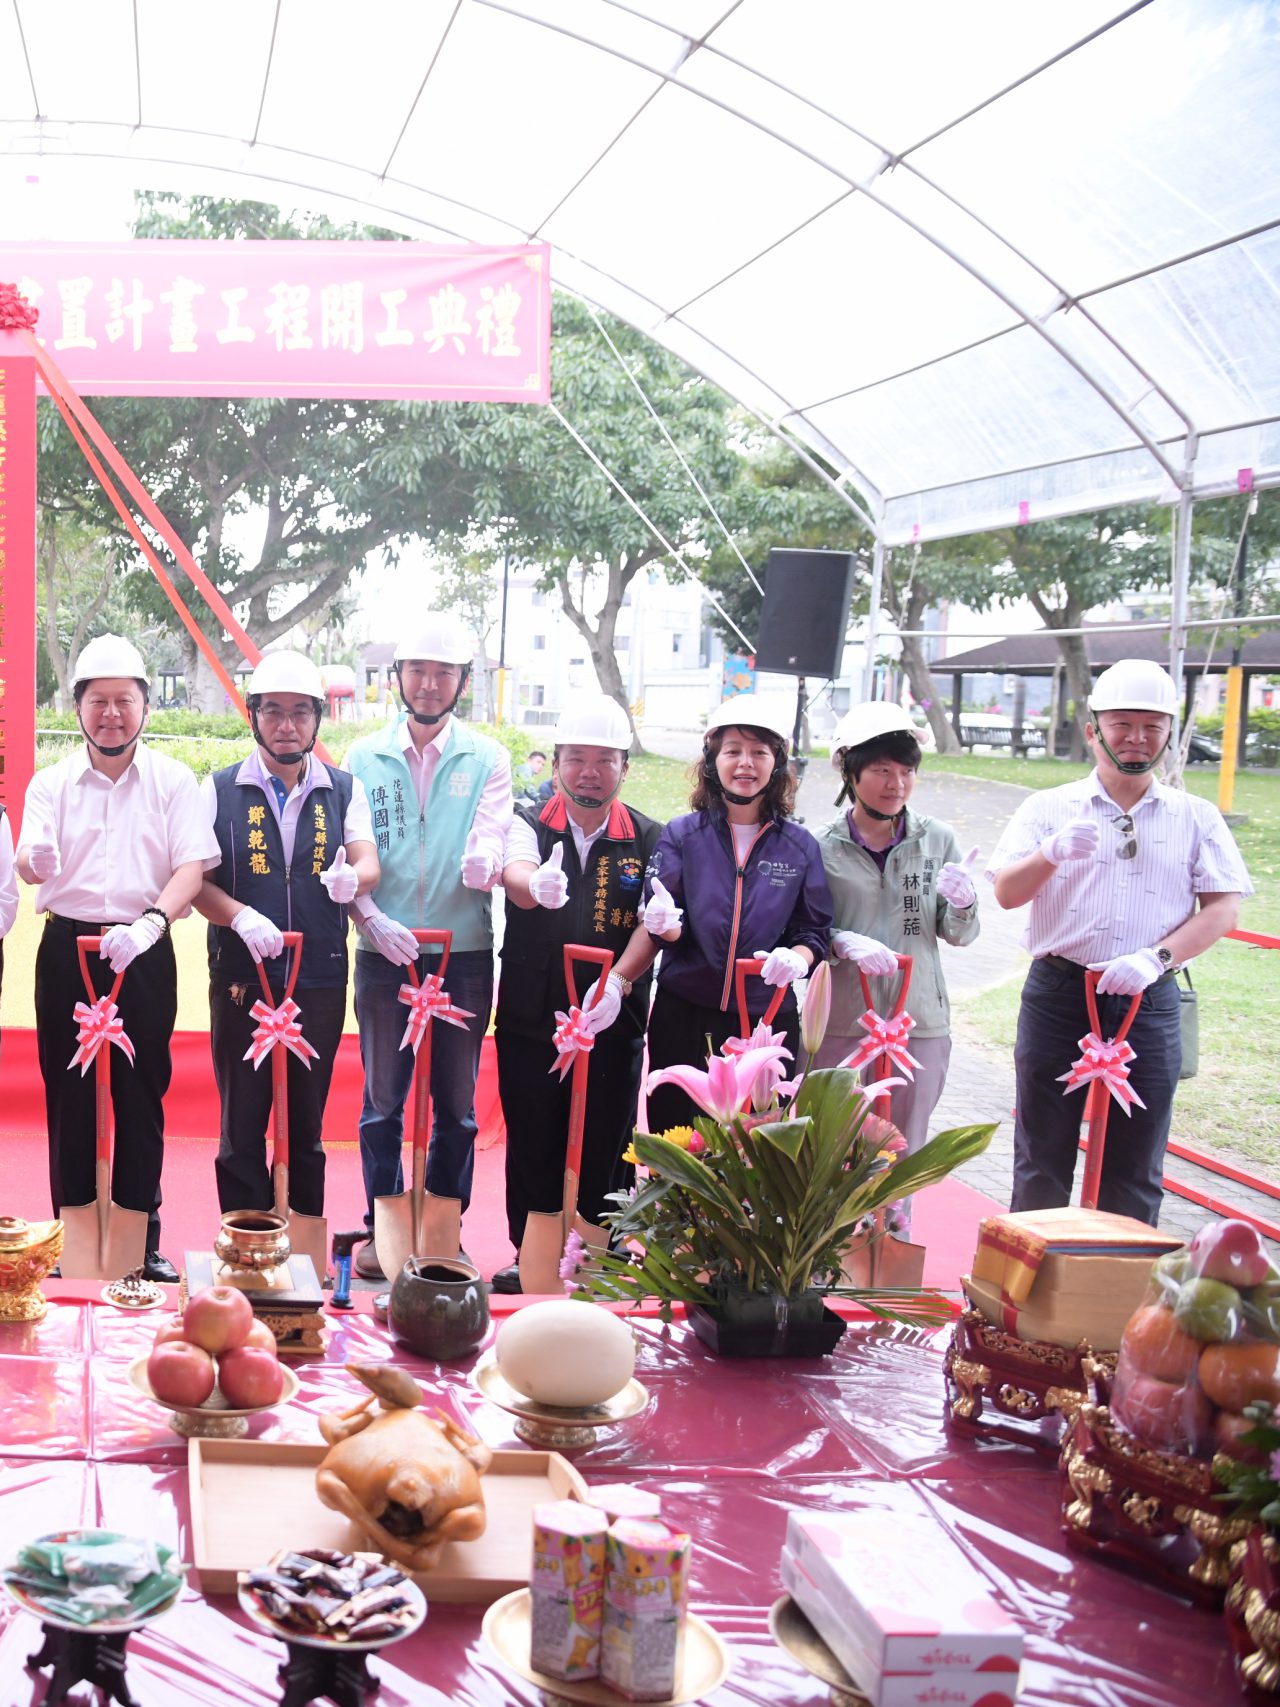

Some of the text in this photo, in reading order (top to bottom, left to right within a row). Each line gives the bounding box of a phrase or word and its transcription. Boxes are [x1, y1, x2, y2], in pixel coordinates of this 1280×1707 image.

[247, 805, 270, 875] 鄭乾龍
[311, 804, 327, 876] 花蓮縣議員
[393, 778, 407, 839] 花蓮縣議員
[593, 855, 610, 933] 客家事務處處長
[922, 859, 934, 896] 縣議員
